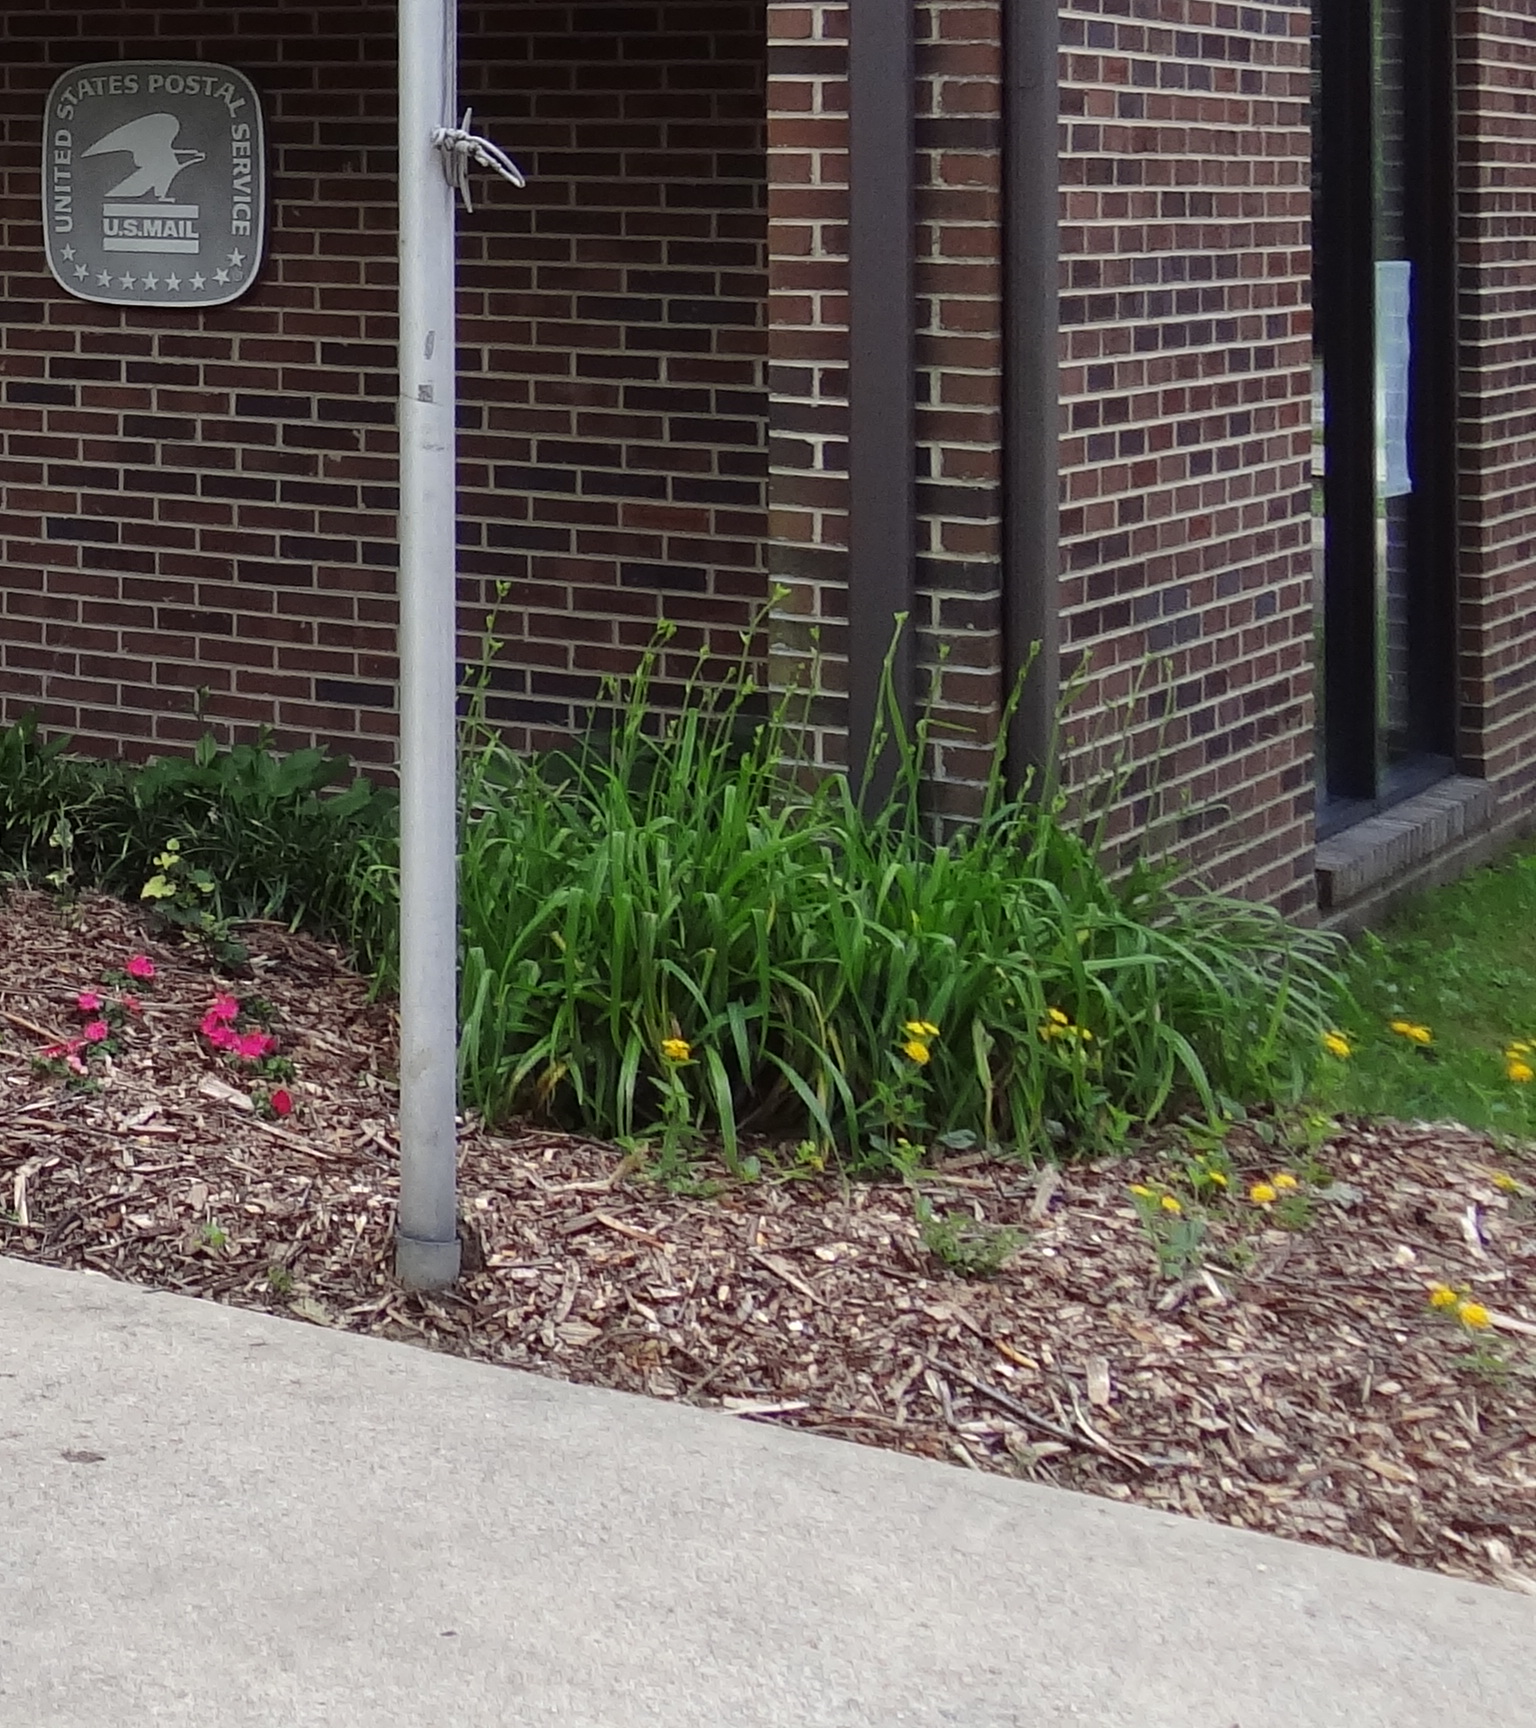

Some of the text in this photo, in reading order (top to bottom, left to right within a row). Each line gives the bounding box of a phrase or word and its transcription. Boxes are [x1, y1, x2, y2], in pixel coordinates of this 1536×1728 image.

[54, 74, 251, 236] UNITED STATES POSTAL SERVICE
